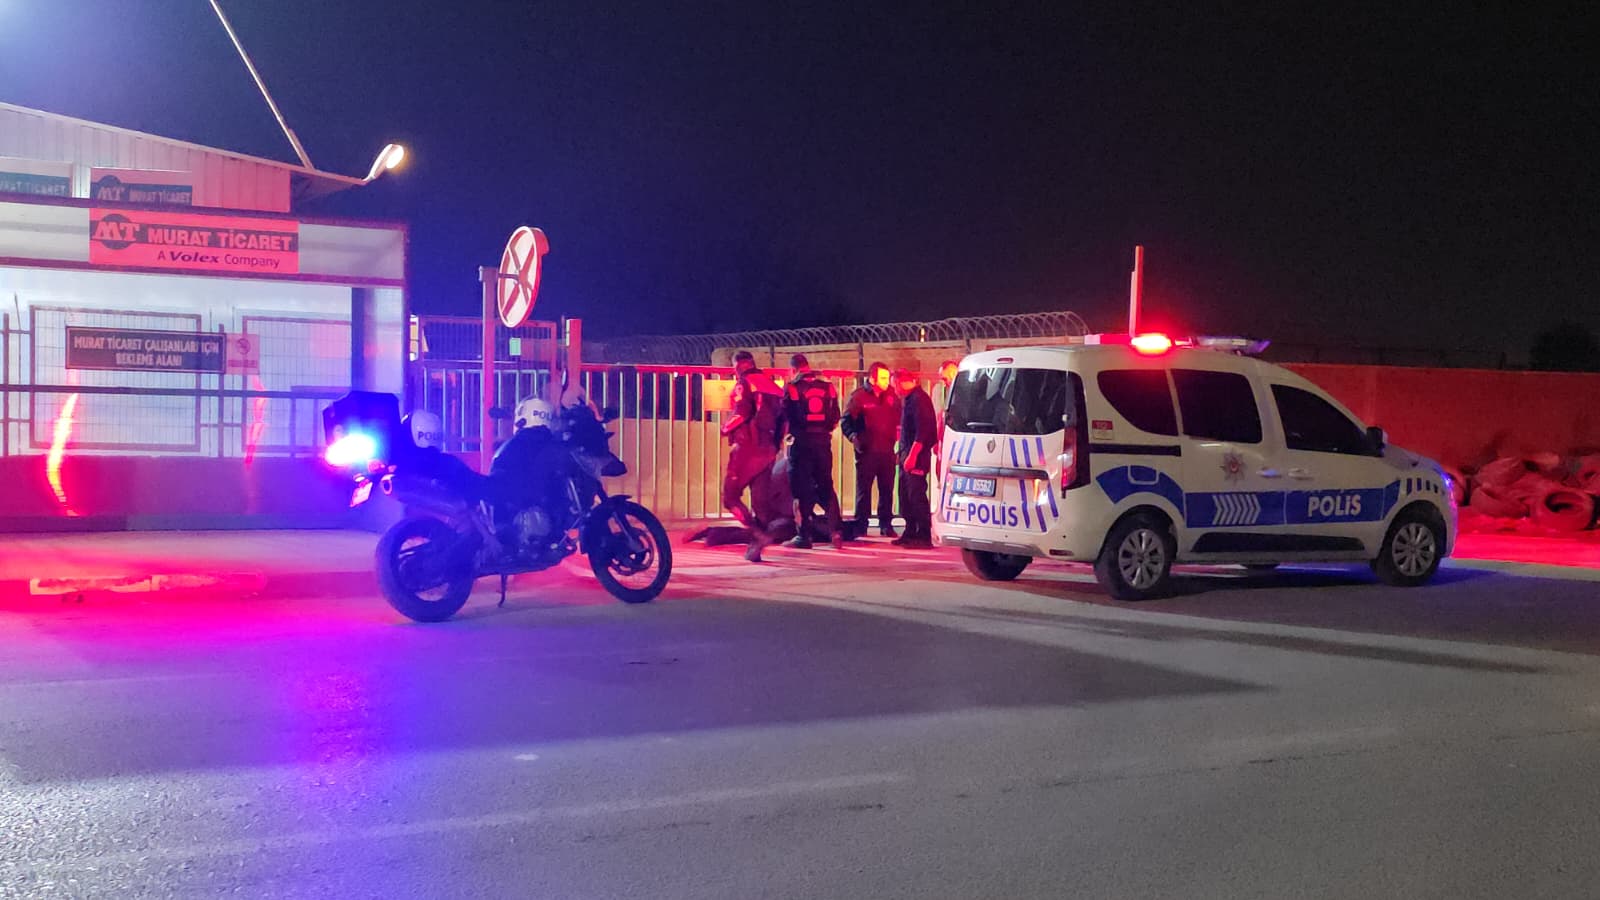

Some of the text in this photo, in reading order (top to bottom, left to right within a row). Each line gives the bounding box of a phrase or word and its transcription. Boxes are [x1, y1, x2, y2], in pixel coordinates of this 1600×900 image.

[92, 221, 292, 251] MT MURAT TİCARET
[157, 250, 280, 268] A Volex Company
[74, 335, 105, 349] MURAT
[155, 354, 182, 367] ALANI
